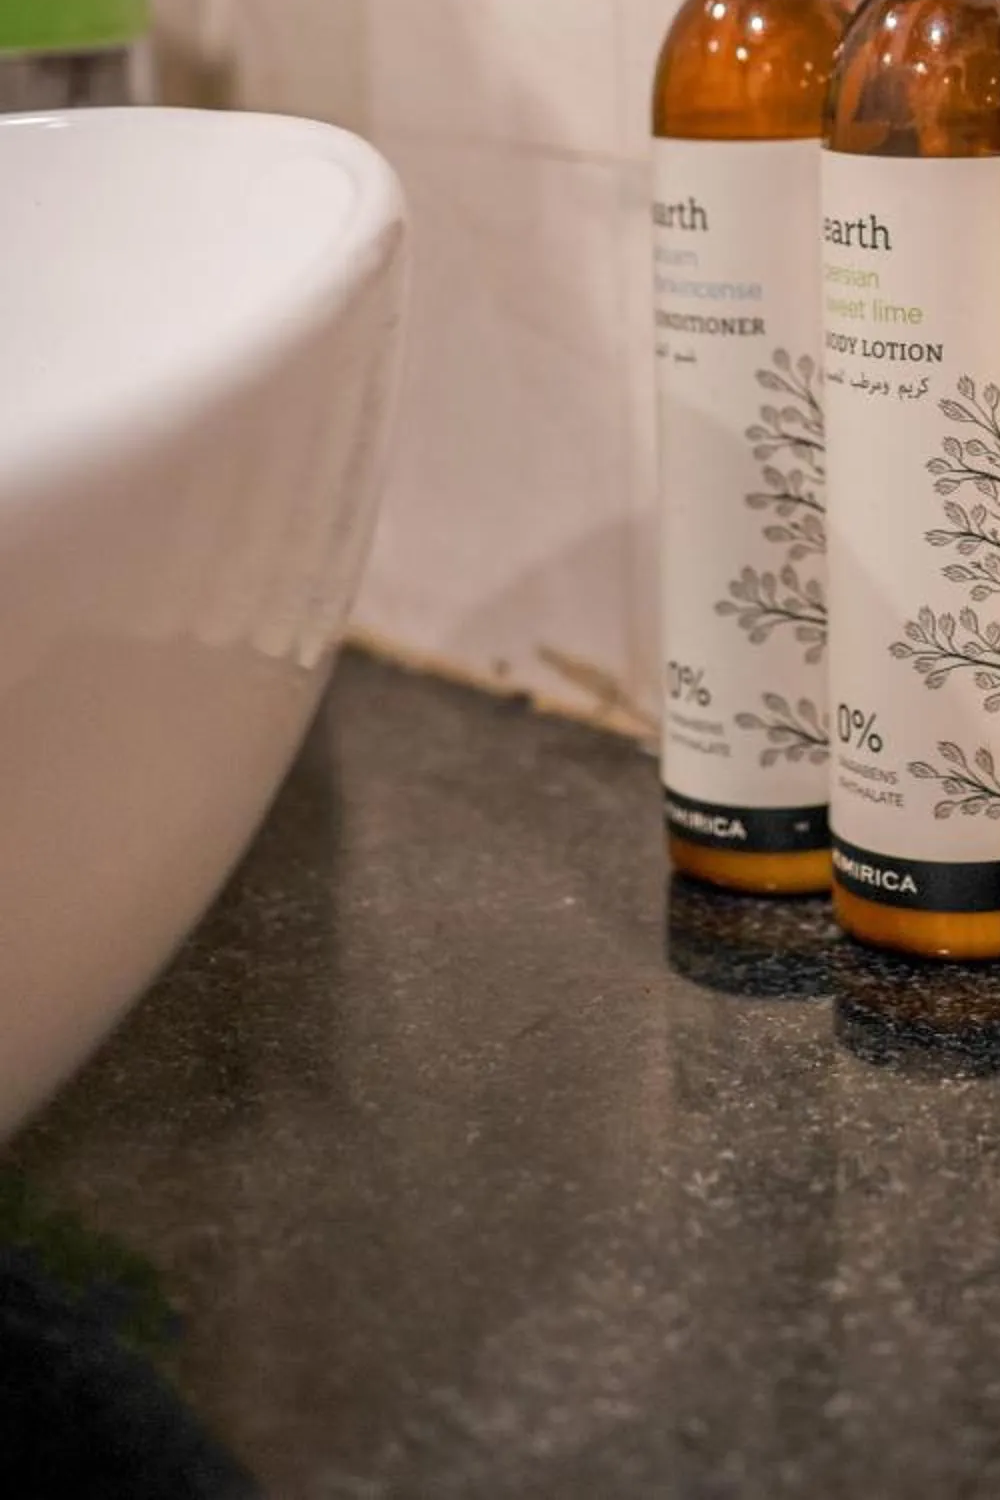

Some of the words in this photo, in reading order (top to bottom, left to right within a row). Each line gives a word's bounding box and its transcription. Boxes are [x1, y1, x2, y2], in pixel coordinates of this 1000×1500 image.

[872, 299, 924, 325] lime
[861, 339, 944, 363] LOTION
[837, 703, 883, 753] 0%
